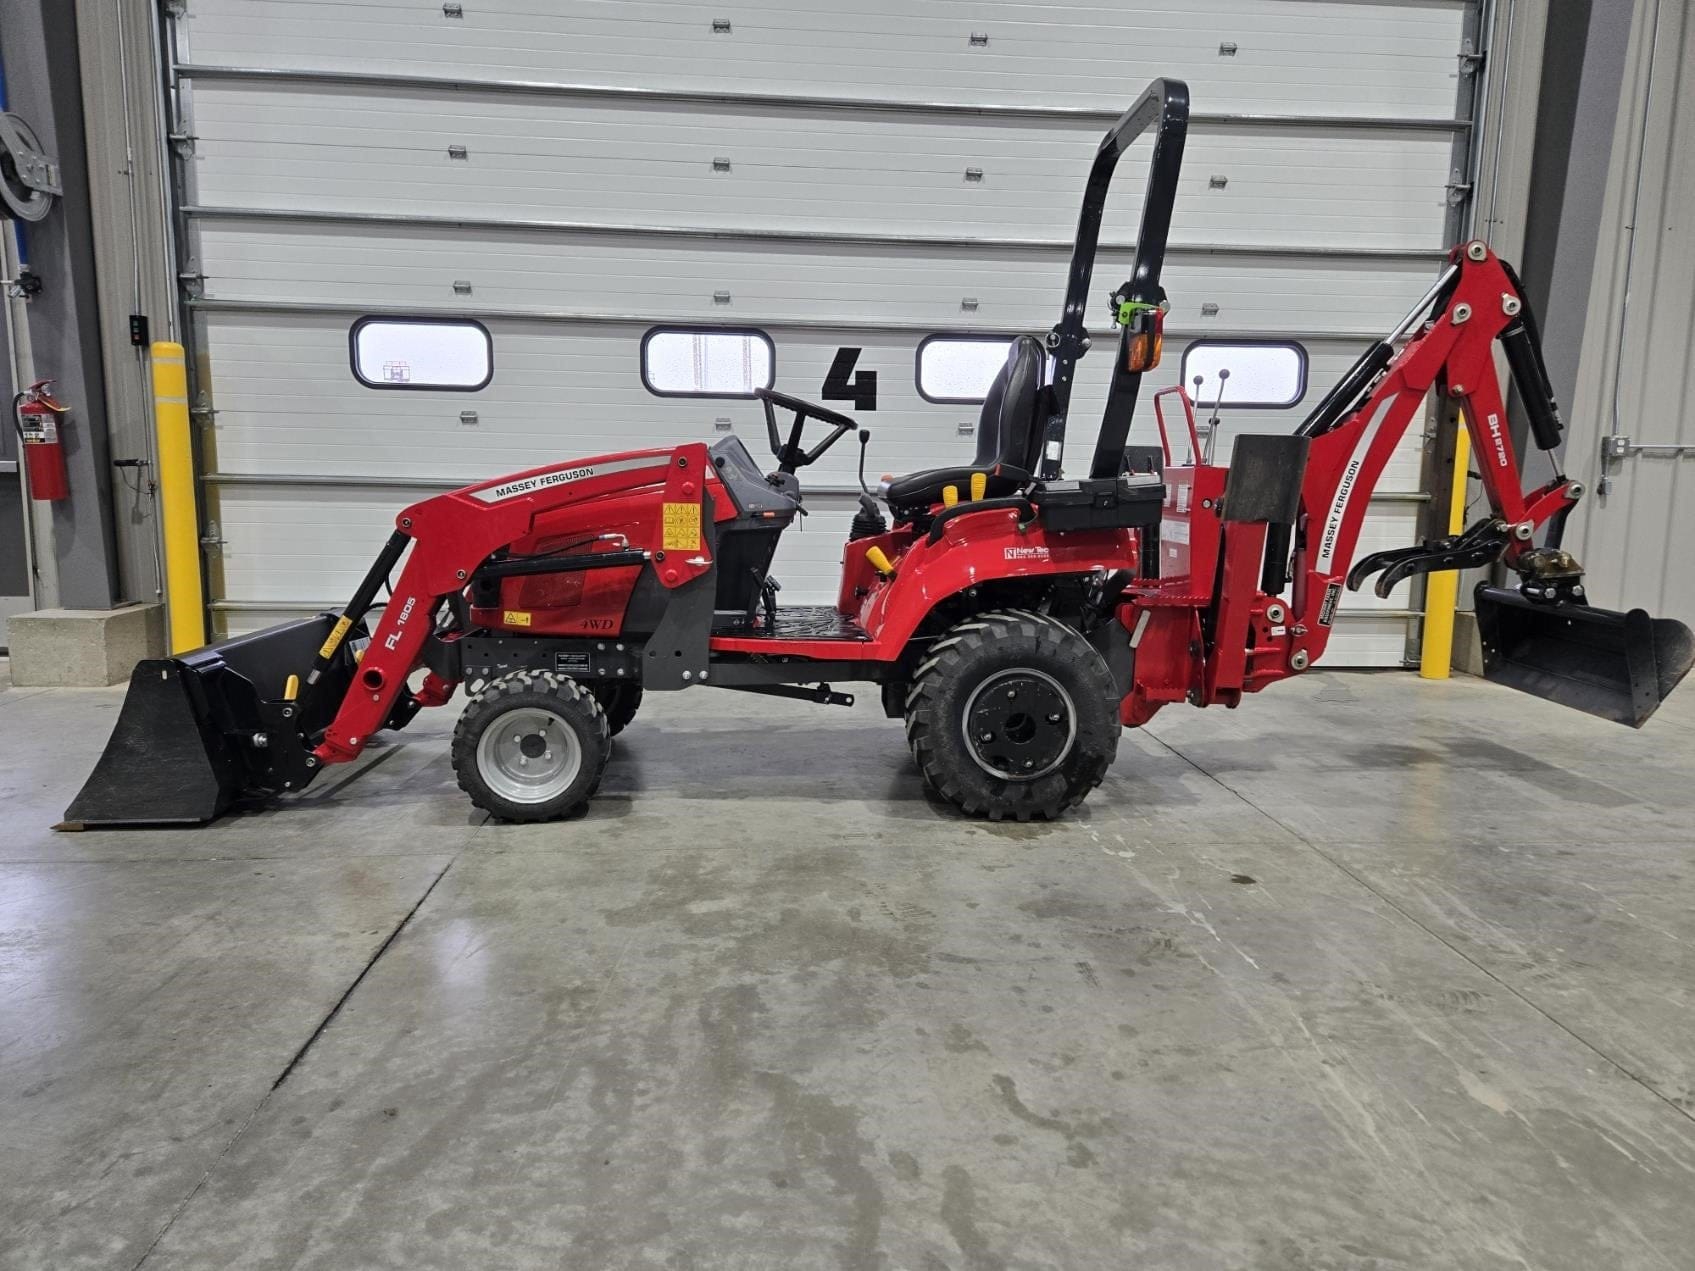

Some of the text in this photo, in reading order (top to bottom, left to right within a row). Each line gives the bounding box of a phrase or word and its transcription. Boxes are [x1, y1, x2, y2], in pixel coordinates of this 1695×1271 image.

[821, 347, 877, 411] 4
[495, 468, 594, 497] MASSEY FERGUSON
[1321, 516, 1338, 558] MASSEY
[1334, 460, 1360, 514] FERGUSON
[385, 596, 416, 650] FL 1805
